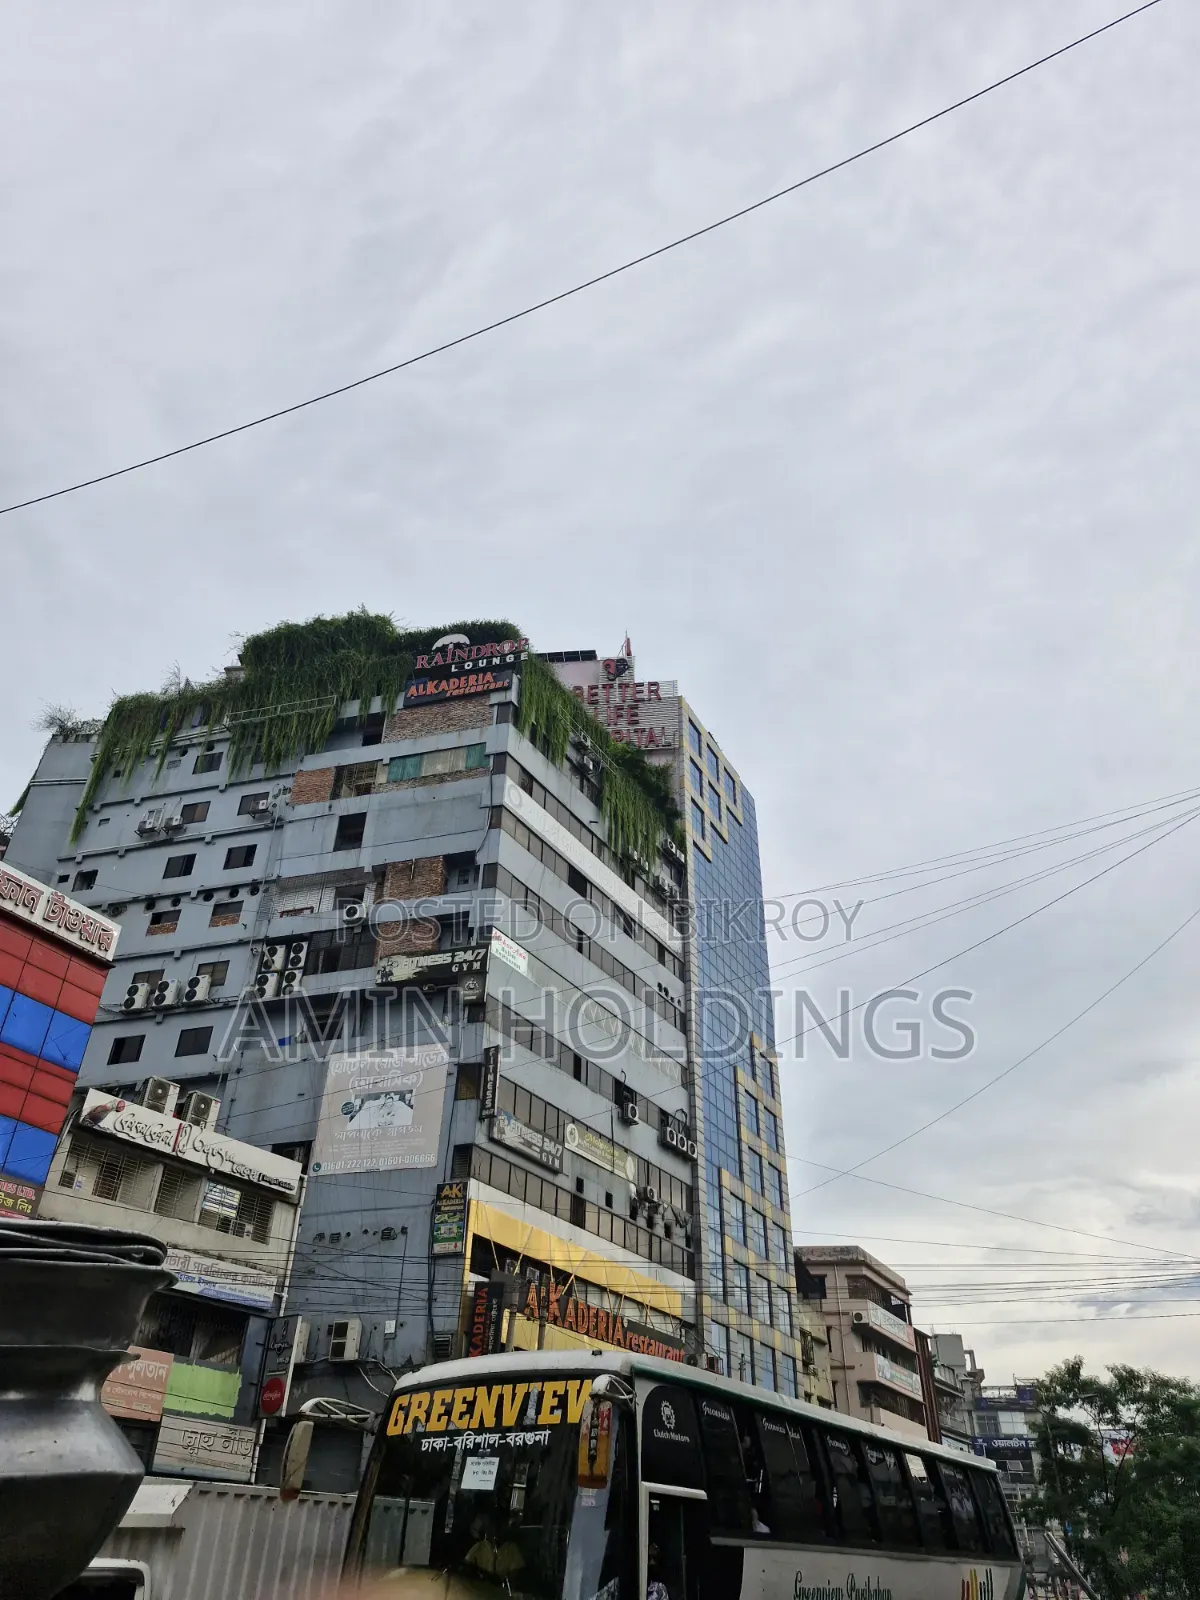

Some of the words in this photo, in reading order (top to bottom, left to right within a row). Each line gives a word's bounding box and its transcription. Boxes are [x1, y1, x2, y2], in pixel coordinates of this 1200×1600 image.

[415, 637, 530, 669] RAINDROP
[451, 651, 529, 673] LOUNGE
[407, 671, 494, 698] ALKADERIA
[445, 679, 510, 697] restaurant
[571, 681, 662, 705] BETTER
[609, 726, 673, 749] PITAL
[402, 953, 453, 969] FITNESS
[452, 948, 488, 963] 24/7
[451, 960, 482, 973] GYM
[484, 1048, 496, 1108] FITNESS
[541, 1154, 561, 1170] GYM
[16, 1185, 36, 1200] LTD.
[439, 1183, 464, 1199] AK
[469, 1287, 489, 1359] KADERIA
[624, 1330, 685, 1363] restaurant
[421, 1428, 552, 1453] ঢাকা-বরিশাল-বরগুনা
